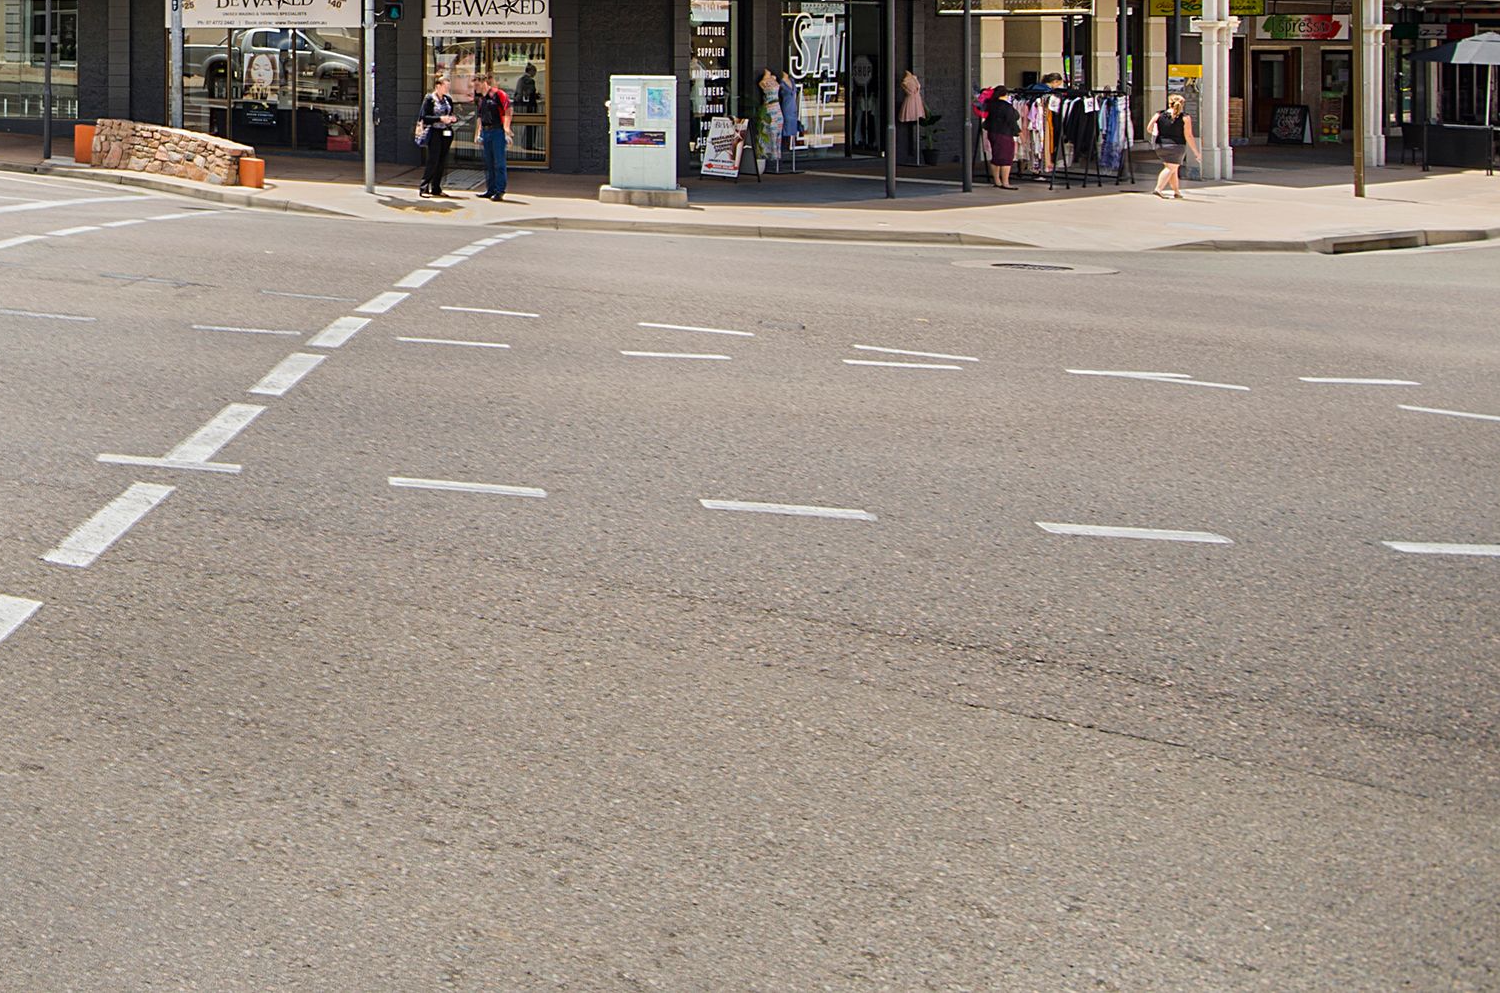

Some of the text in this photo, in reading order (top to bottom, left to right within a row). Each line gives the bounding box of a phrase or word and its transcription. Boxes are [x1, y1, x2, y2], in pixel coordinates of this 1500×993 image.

[696, 26, 725, 36] BOUTIQUE
[697, 47, 725, 57] SUPPLIER
[698, 86, 724, 96] WOMENS
